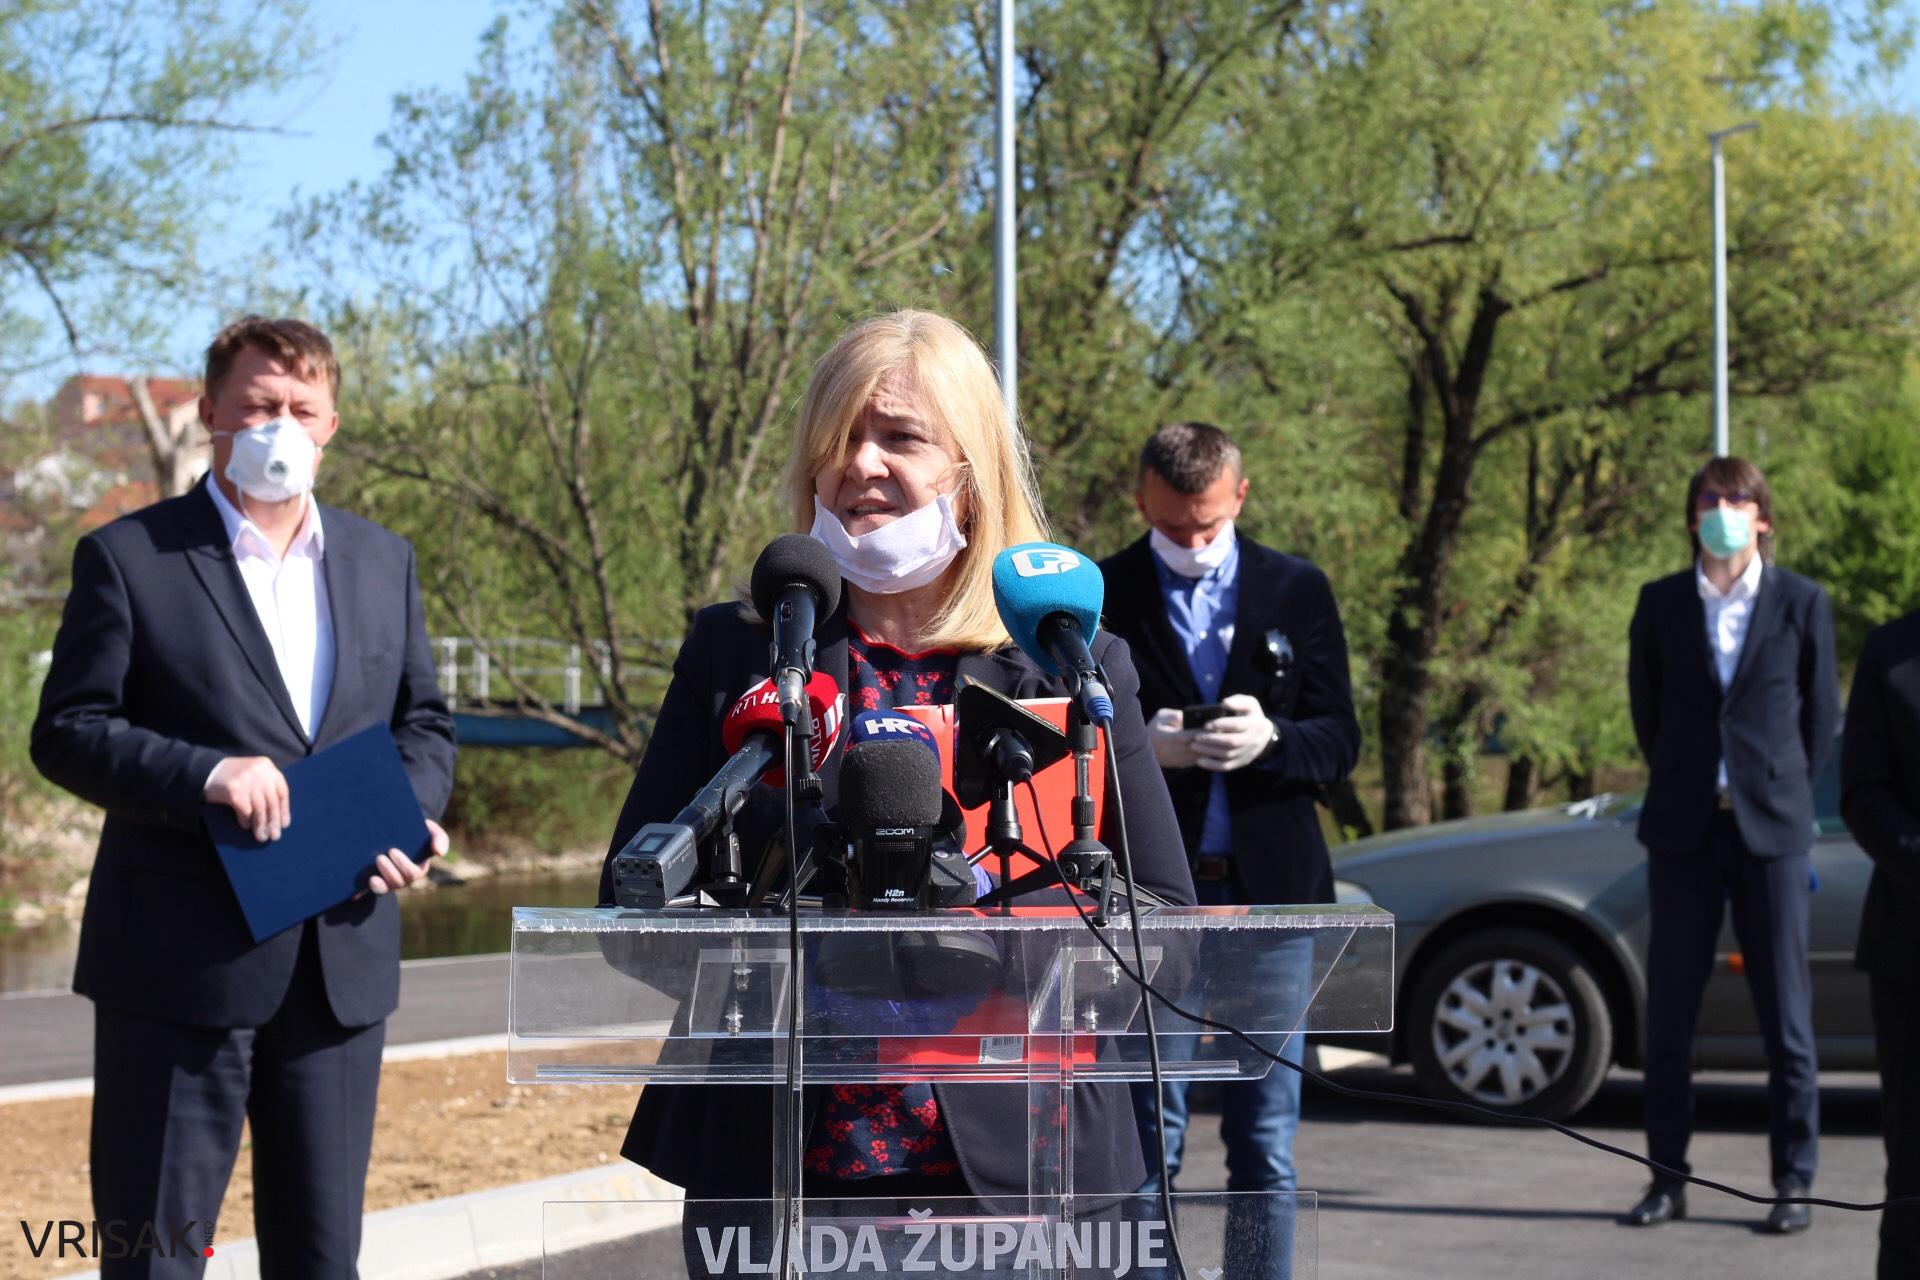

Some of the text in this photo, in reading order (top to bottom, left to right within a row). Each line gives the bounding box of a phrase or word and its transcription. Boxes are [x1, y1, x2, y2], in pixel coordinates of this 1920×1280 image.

[760, 691, 780, 705] H
[876, 828, 915, 836] ZOOM
[885, 889, 905, 897] H2n
[696, 1207, 1168, 1279] VLADA ŽUPANIJE
